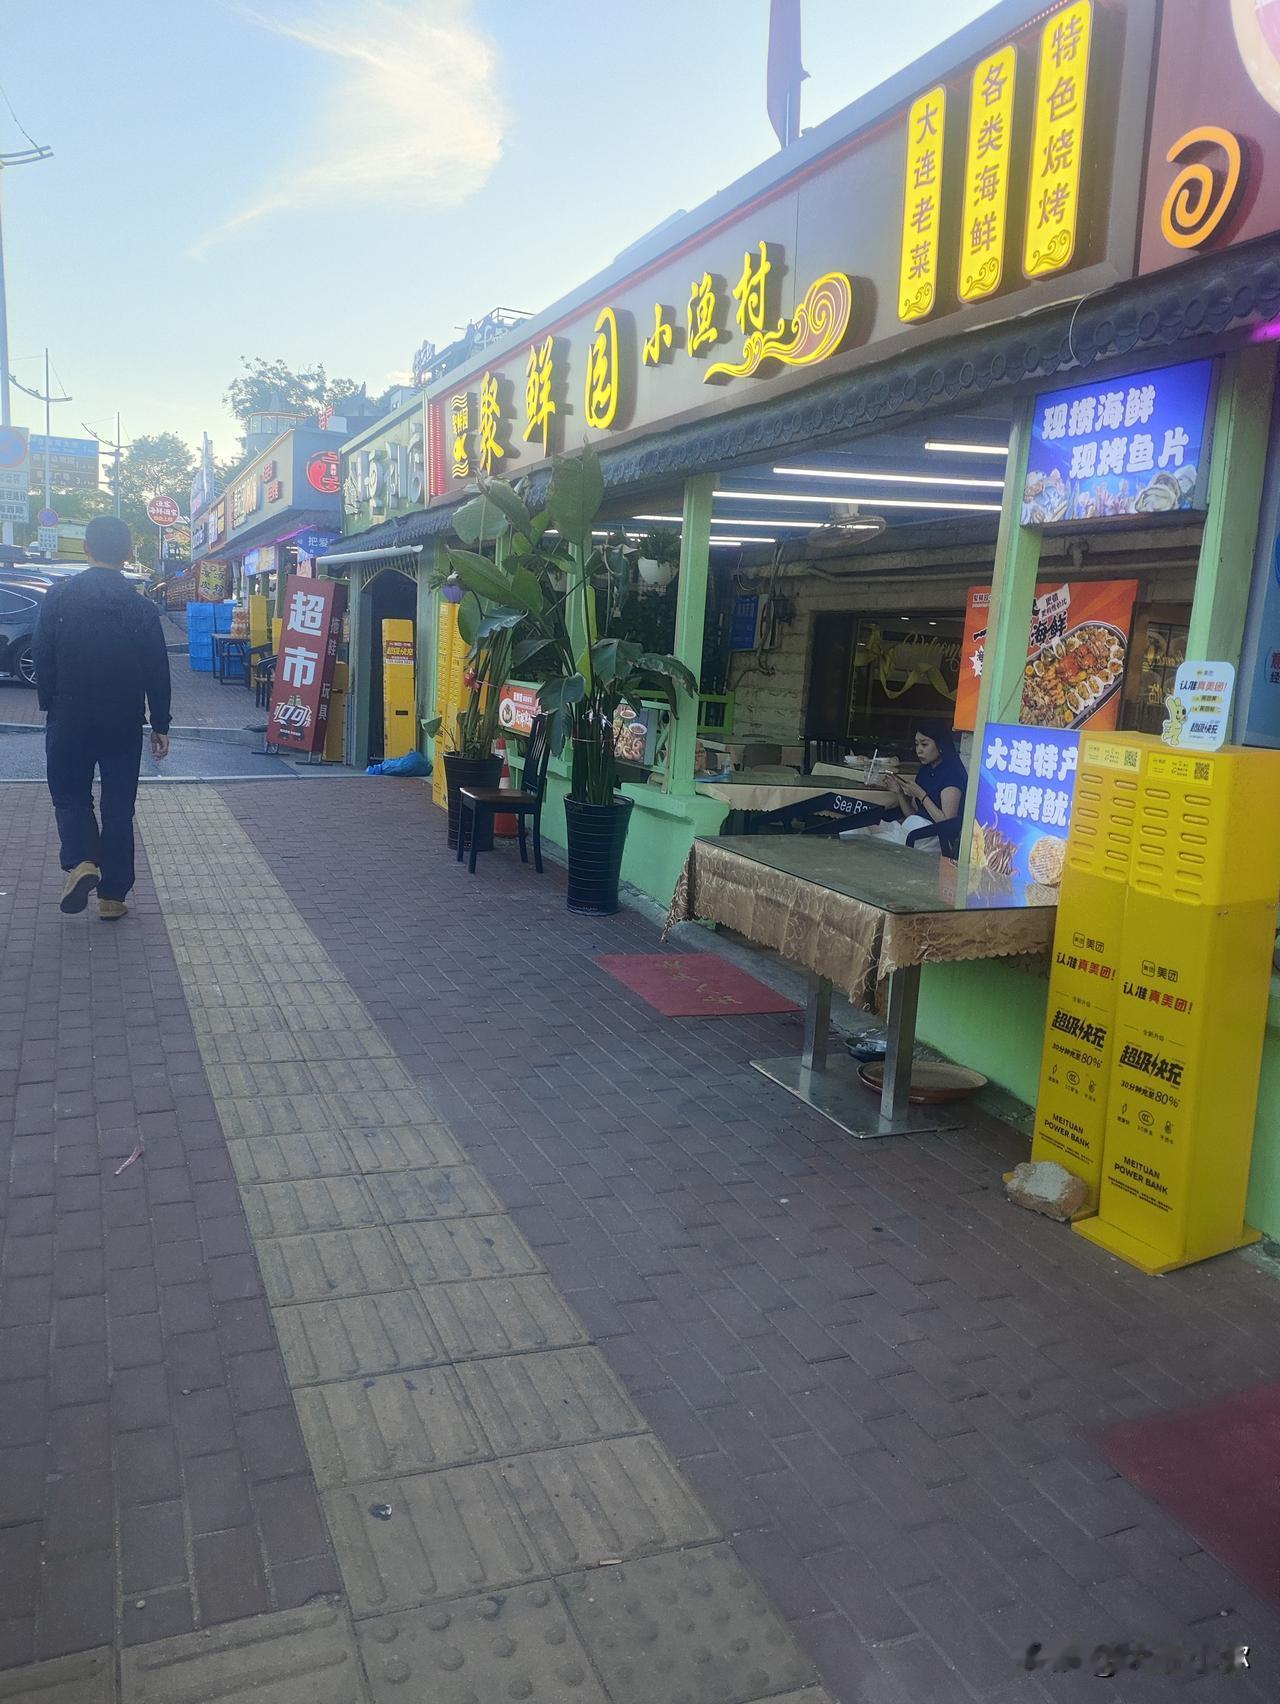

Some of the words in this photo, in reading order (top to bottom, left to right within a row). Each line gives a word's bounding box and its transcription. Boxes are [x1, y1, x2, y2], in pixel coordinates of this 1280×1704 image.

[1036, 14, 1085, 230] 特色烧烤
[970, 62, 1008, 256] 各类海鲜
[908, 103, 939, 281] 大连老菜
[478, 306, 620, 476] 聚鲜园
[642, 240, 771, 366] 小渔村
[1069, 427, 1190, 480] 现烤鱼片
[283, 591, 325, 689] 超市
[986, 738, 1079, 781] 大连特产
[833, 795, 853, 813] Sea
[994, 782, 1074, 828] 现烤鱿
[1056, 952, 1116, 981] 认准真美团!
[1157, 966, 1178, 983] 美团
[1123, 981, 1193, 1015] 认准真美团!
[1051, 1009, 1107, 1049] 超级快充
[1119, 1044, 1184, 1086] 超级快充
[1044, 1120, 1070, 1138] POWER
[1069, 1133, 1090, 1150] BANK
[1052, 1113, 1083, 1135] MEITUAN
[1114, 1163, 1144, 1184] POWER
[1144, 1178, 1168, 1196] BANK
[1123, 1156, 1160, 1180] MEITUAN
